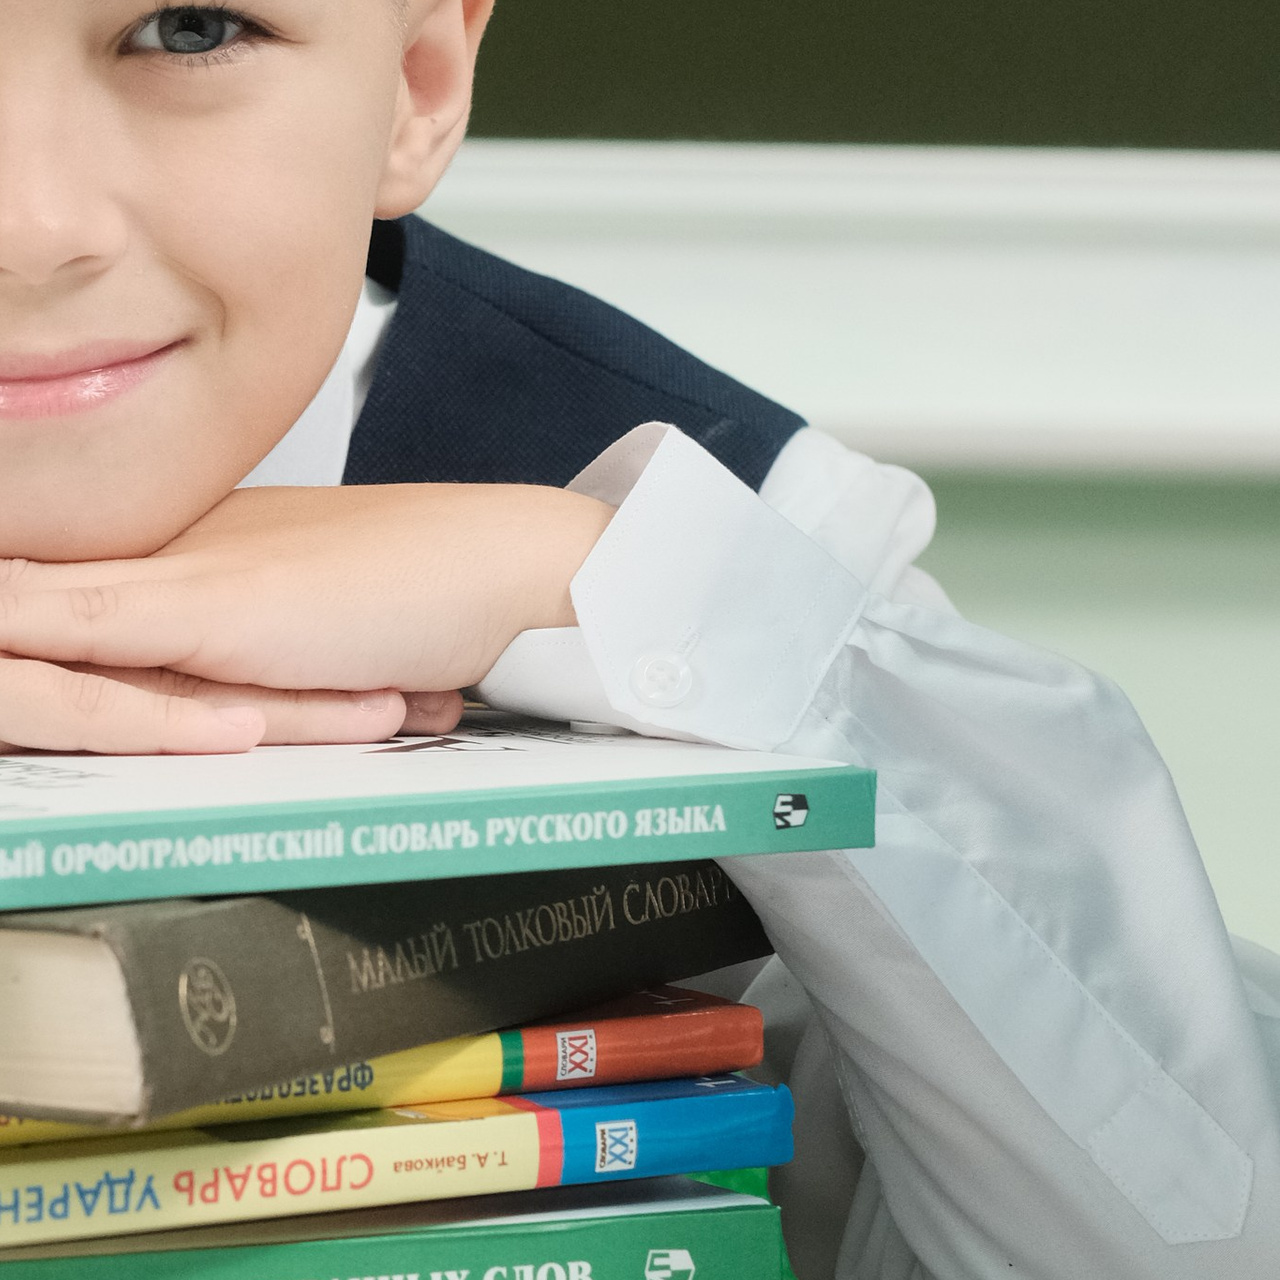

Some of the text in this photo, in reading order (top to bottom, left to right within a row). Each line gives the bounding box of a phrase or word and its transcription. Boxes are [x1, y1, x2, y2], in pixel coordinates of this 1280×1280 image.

[52, 821, 345, 876] ОРФОГРАФИЧЕСКИЙ
[351, 820, 479, 857] СЛОВАРЬ
[486, 809, 628, 847] РУССКОГО
[634, 804, 726, 837] ЯЗЫКА
[346, 922, 459, 993] МАЛЫЙ
[463, 884, 615, 962] ТОЛКОВЫЙ
[174, 1153, 374, 1206] СЛОВАРЬ
[392, 1154, 467, 1173] Байкова
